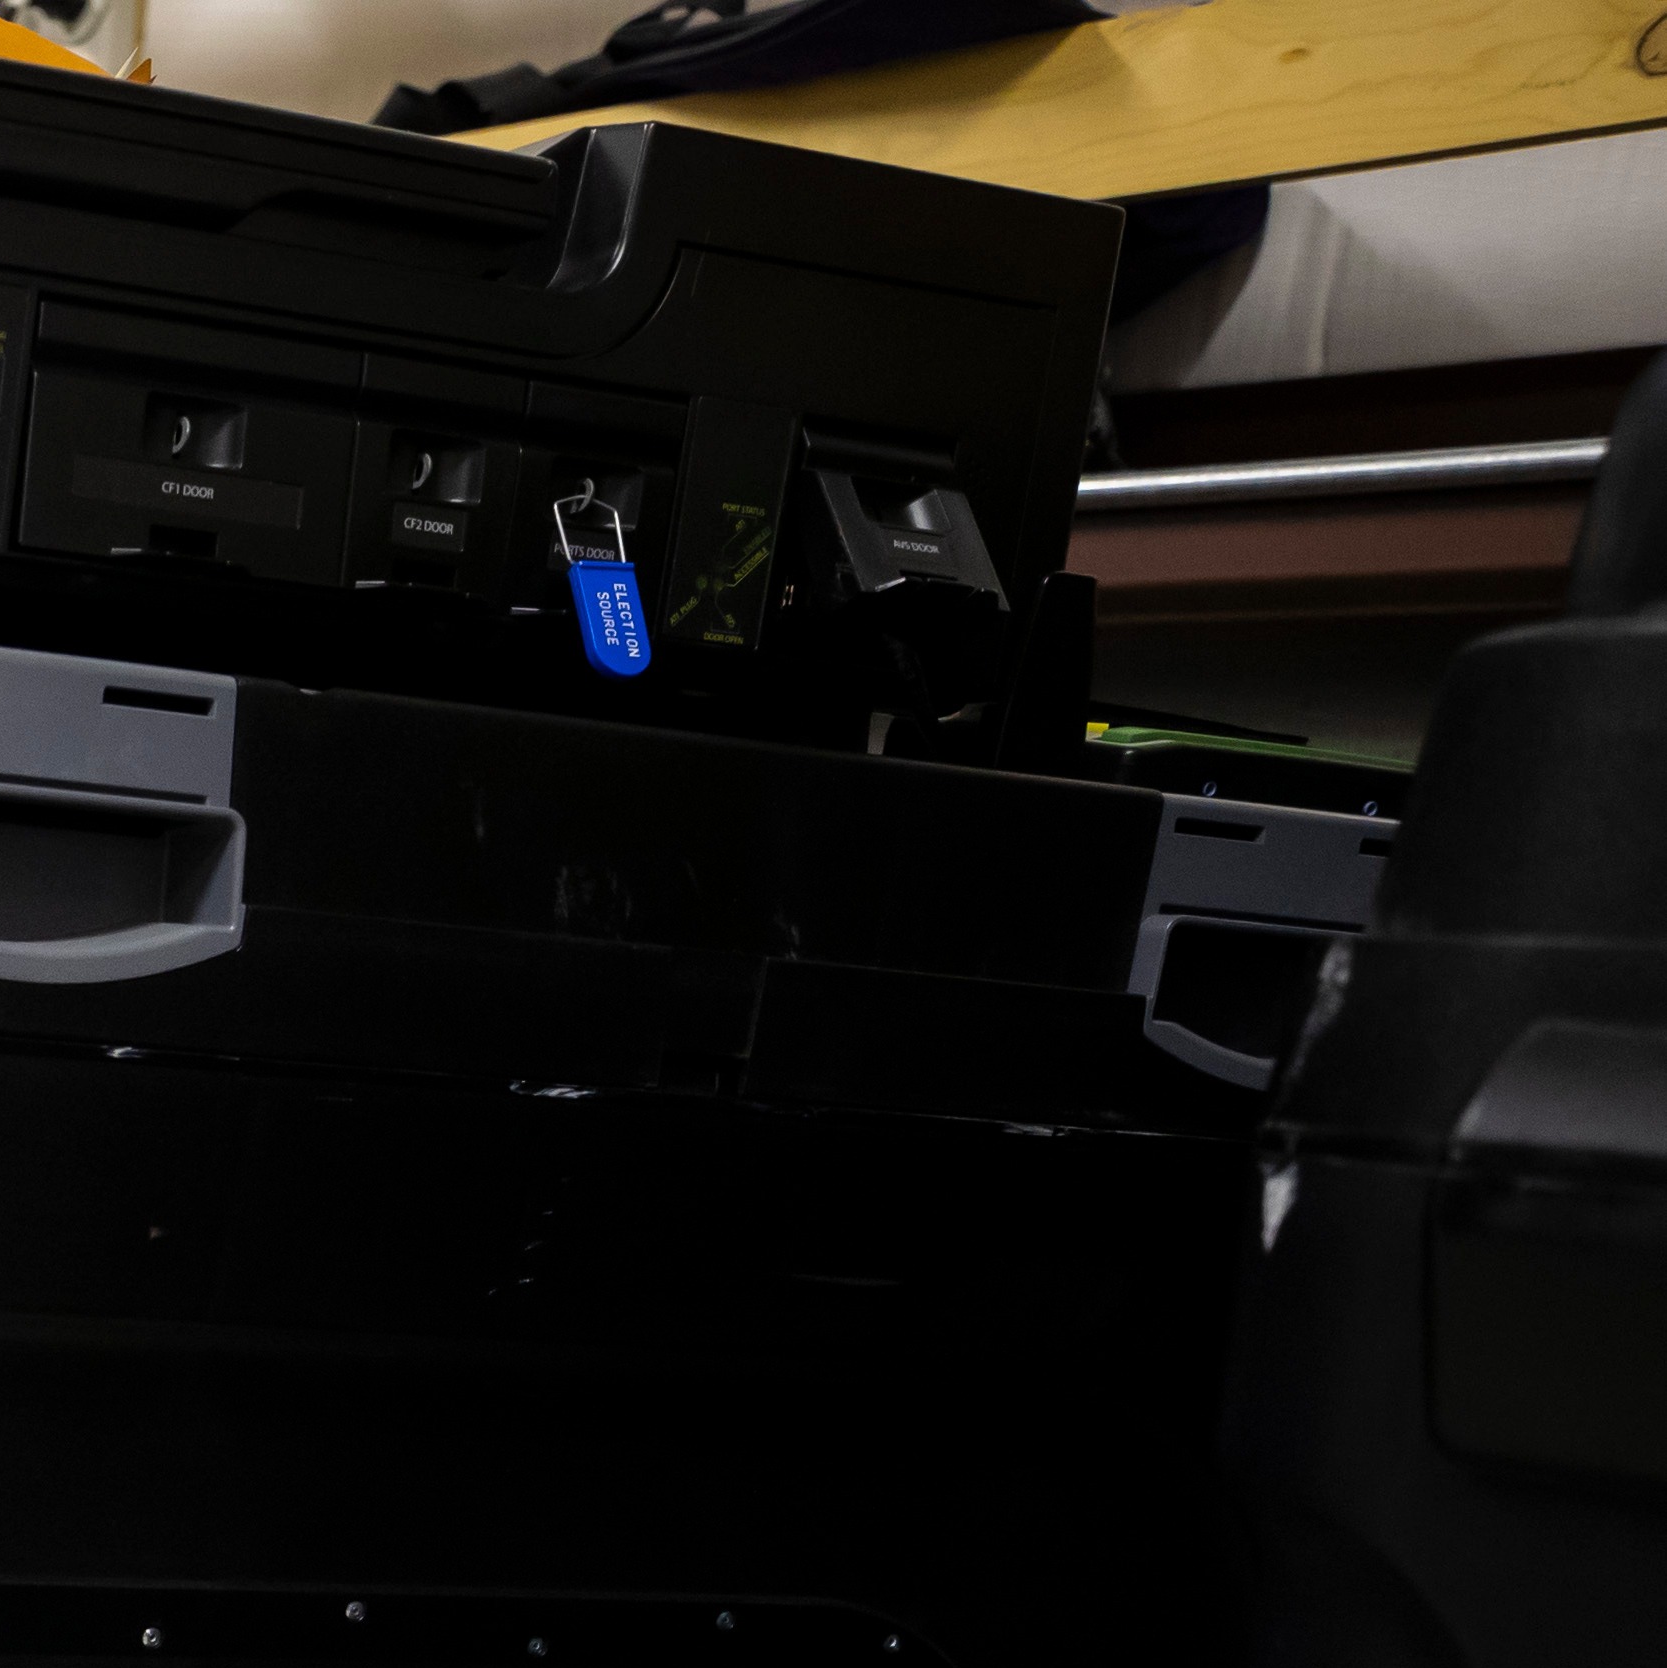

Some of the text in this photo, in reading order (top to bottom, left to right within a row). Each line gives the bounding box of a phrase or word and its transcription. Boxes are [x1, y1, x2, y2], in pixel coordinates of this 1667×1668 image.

[161, 480, 214, 501] CF1 DOOR
[722, 502, 766, 517] PORT STATUS
[403, 516, 454, 536] CF2 DOOR
[586, 547, 615, 560] DOOR
[912, 542, 941, 554] DOOR
[733, 546, 769, 580] ACCESSIBLE
[597, 591, 620, 646] SOURCE
[613, 583, 641, 658] ELECTION
[703, 631, 745, 645] DOOR OPEN
